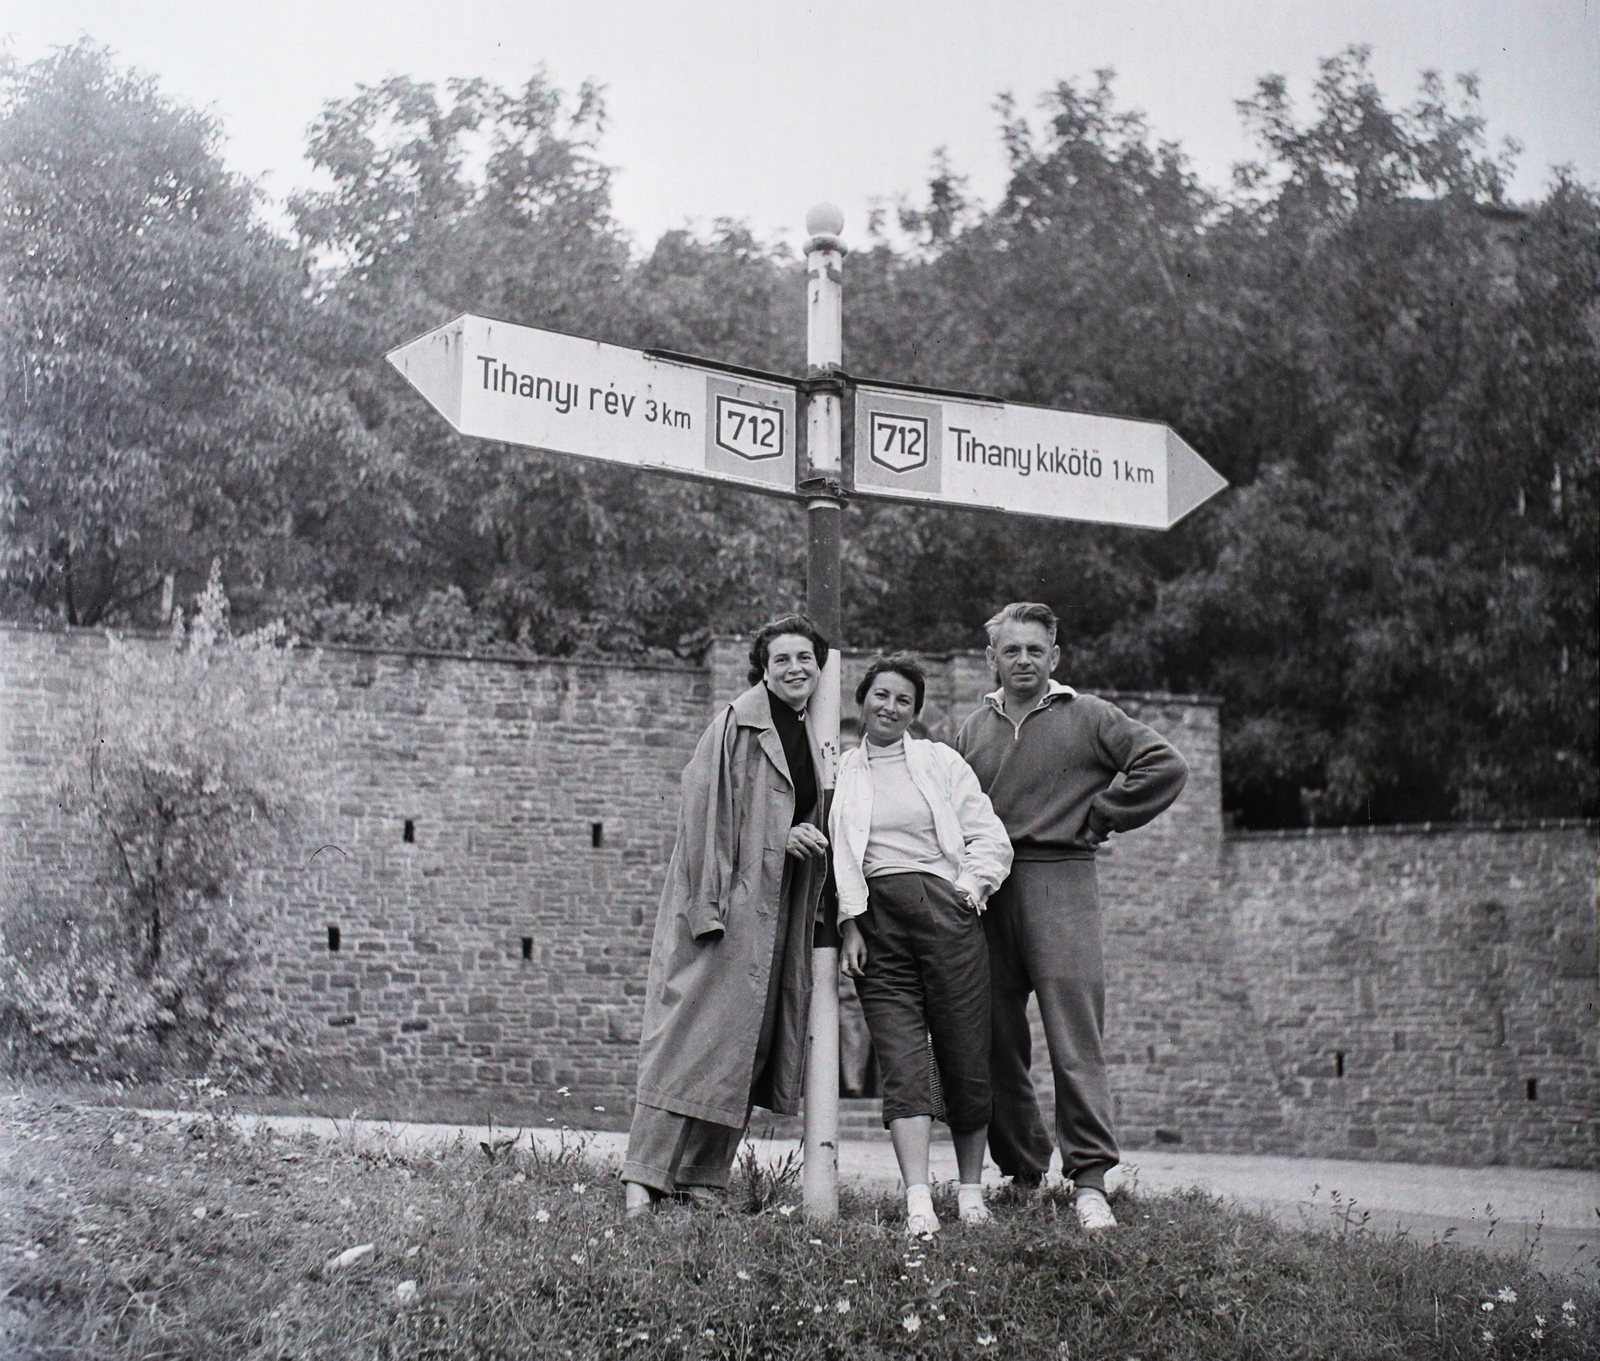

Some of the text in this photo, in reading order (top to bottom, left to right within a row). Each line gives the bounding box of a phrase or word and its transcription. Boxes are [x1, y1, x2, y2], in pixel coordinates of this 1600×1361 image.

[476, 355, 578, 414] Tihanyi
[588, 382, 636, 417] rév
[726, 410, 777, 448] 712
[878, 423, 922, 457] 712
[948, 426, 1031, 476] Tihany
